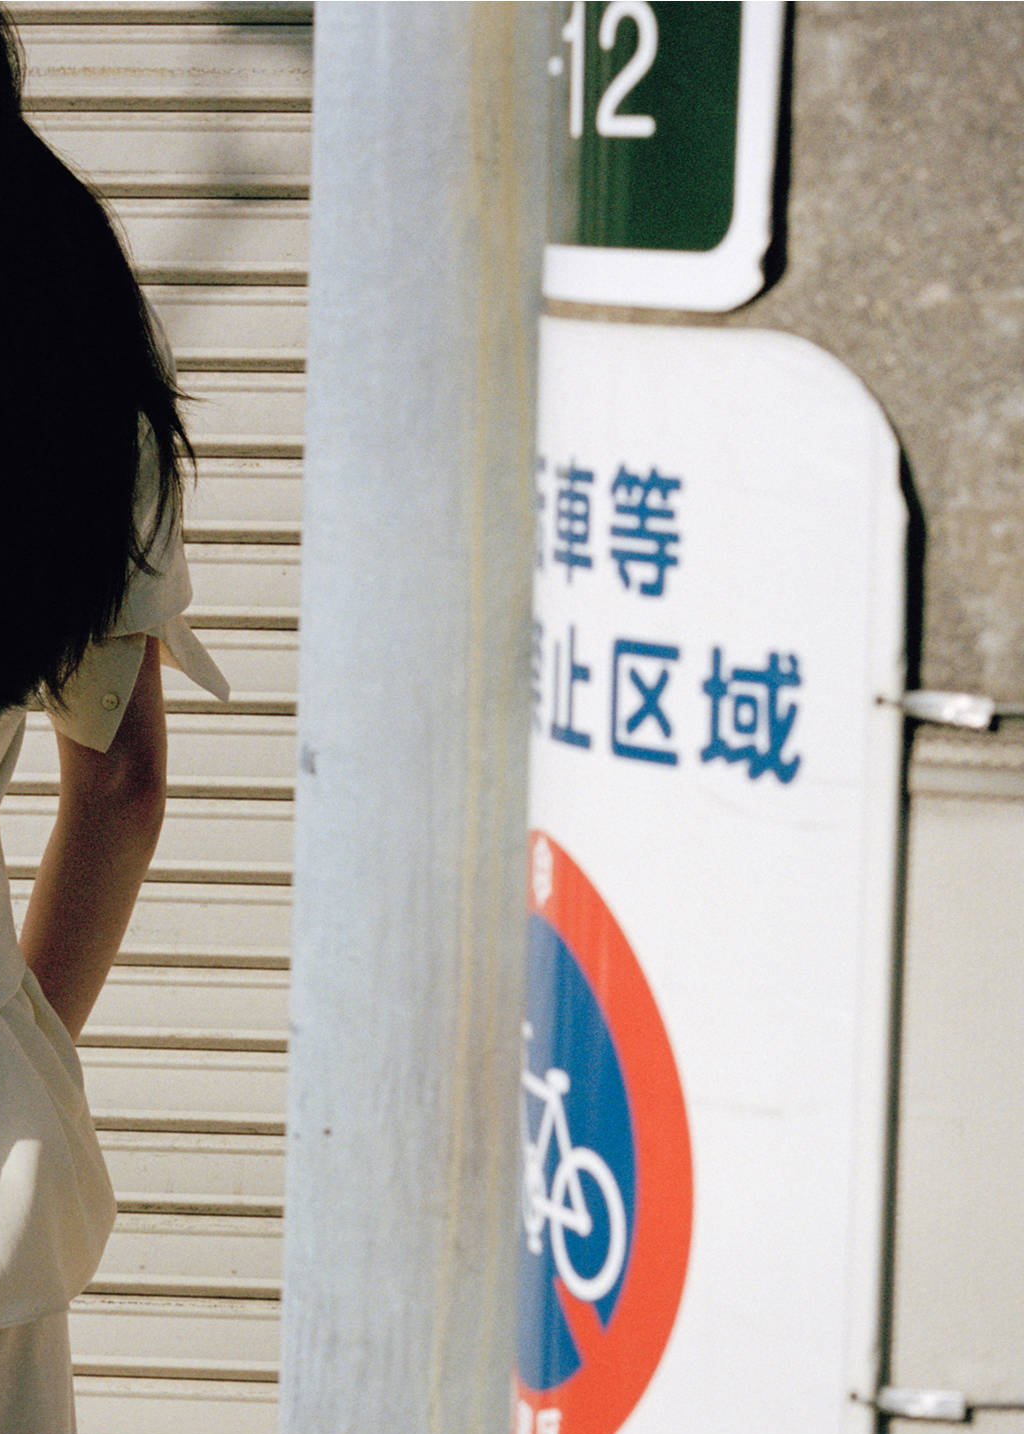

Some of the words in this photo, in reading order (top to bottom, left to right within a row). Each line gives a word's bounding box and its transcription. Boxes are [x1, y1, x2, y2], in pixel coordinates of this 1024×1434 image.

[536, 457, 681, 597] 車等
[533, 622, 802, 784] 止区域
